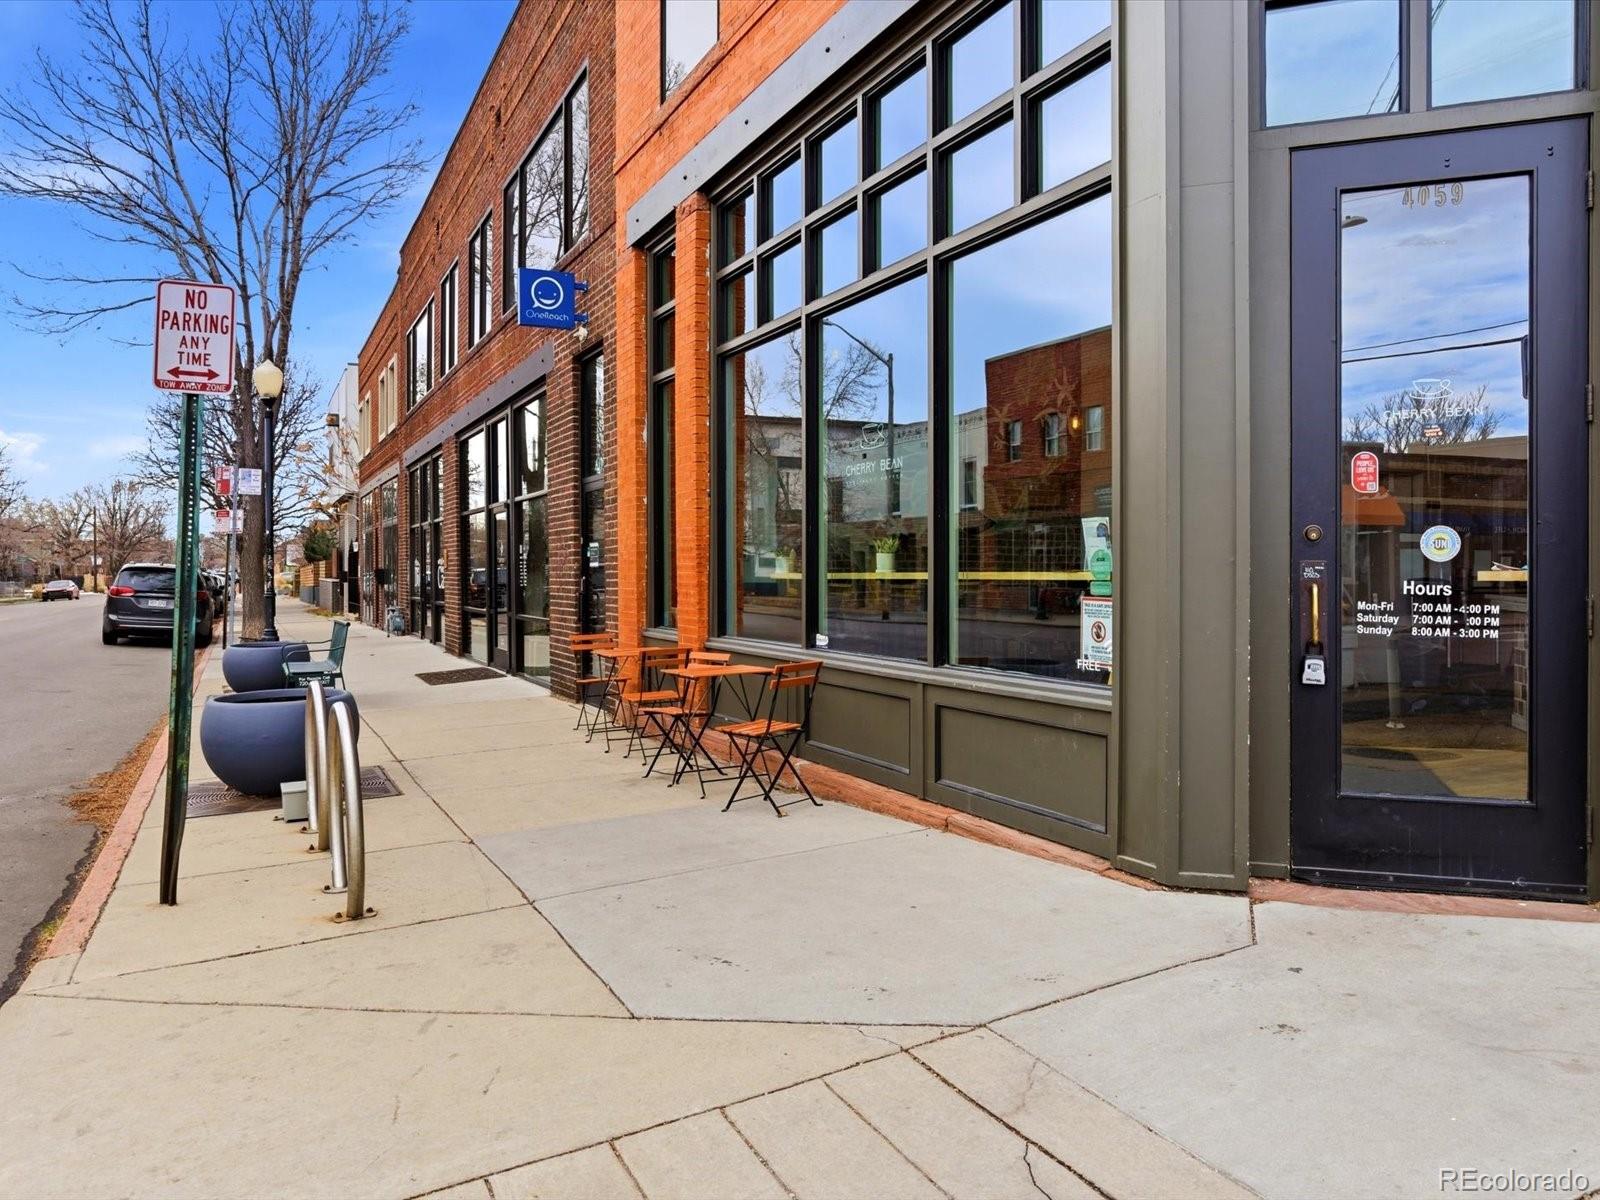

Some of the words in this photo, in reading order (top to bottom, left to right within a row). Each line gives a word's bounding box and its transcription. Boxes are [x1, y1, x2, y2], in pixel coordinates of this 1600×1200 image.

[1402, 182, 1464, 209] 4059
[185, 289, 207, 309] NO
[161, 310, 229, 335] PARKING
[179, 335, 210, 350] ANY
[177, 351, 212, 367] TIME
[160, 381, 176, 389] TOW
[180, 382, 202, 391] AWAY
[206, 384, 227, 392] ZONE
[1384, 407, 1437, 419] CHERRY
[1446, 406, 1484, 417] BEAN
[846, 460, 876, 477] CHERRY
[880, 456, 903, 471] BEAN
[1403, 581, 1452, 596] Hours
[1357, 601, 1394, 611] Mon-Fri
[1412, 603, 1433, 613] 7:00
[1435, 603, 1452, 613] AM
[1459, 604, 1481, 614] 4:00
[1484, 605, 1500, 614] PM
[1356, 613, 1399, 625] Saturday
[1412, 615, 1433, 624] 7:00
[1435, 616, 1452, 625] AM
[1483, 617, 1500, 627] PM
[1356, 625, 1393, 637] Sunday
[1411, 627, 1432, 636] 8:00
[1434, 628, 1450, 637] AM
[1459, 628, 1480, 638] 3:00
[1482, 629, 1499, 638] PM
[1077, 659, 1101, 672] FREE
